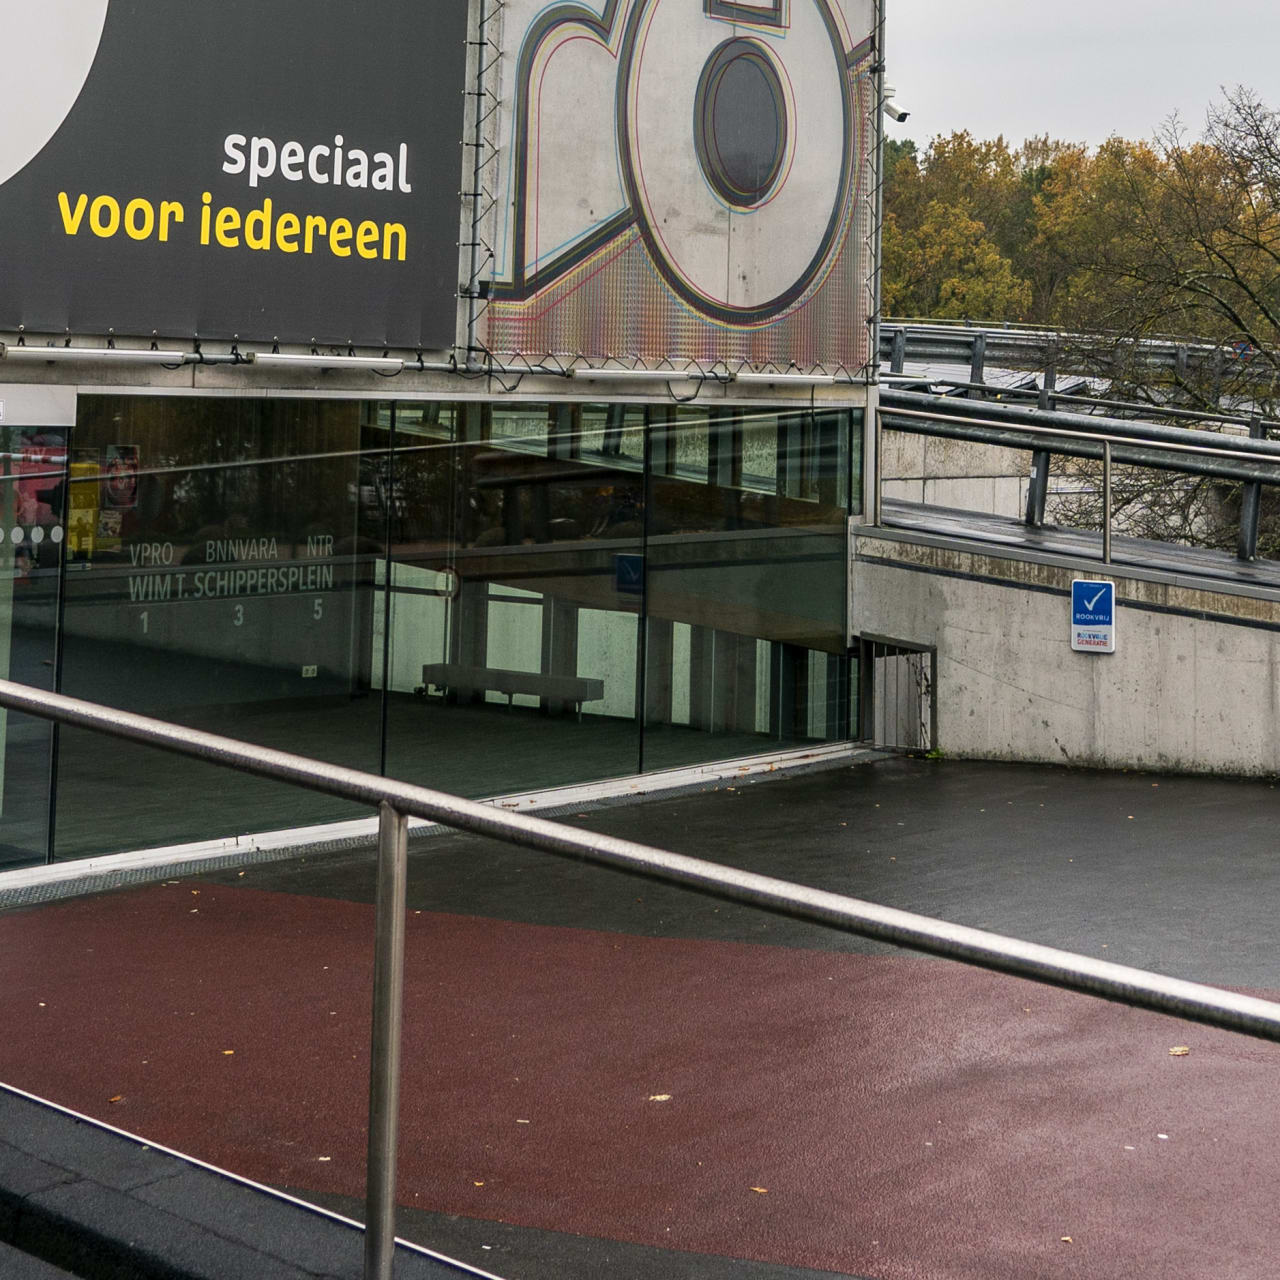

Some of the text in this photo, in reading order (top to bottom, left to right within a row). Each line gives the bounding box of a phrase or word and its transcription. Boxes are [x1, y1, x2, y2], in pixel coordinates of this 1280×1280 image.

[221, 133, 413, 194] speciaal
[57, 191, 408, 261] voor iedereen
[130, 534, 334, 567] VPRO BNNVARA NTR
[128, 565, 333, 602] WIM T. SCHIPPERSPLEIN
[139, 598, 324, 634] 1 3 5
[1076, 613, 1109, 621] ROOKVRIJ
